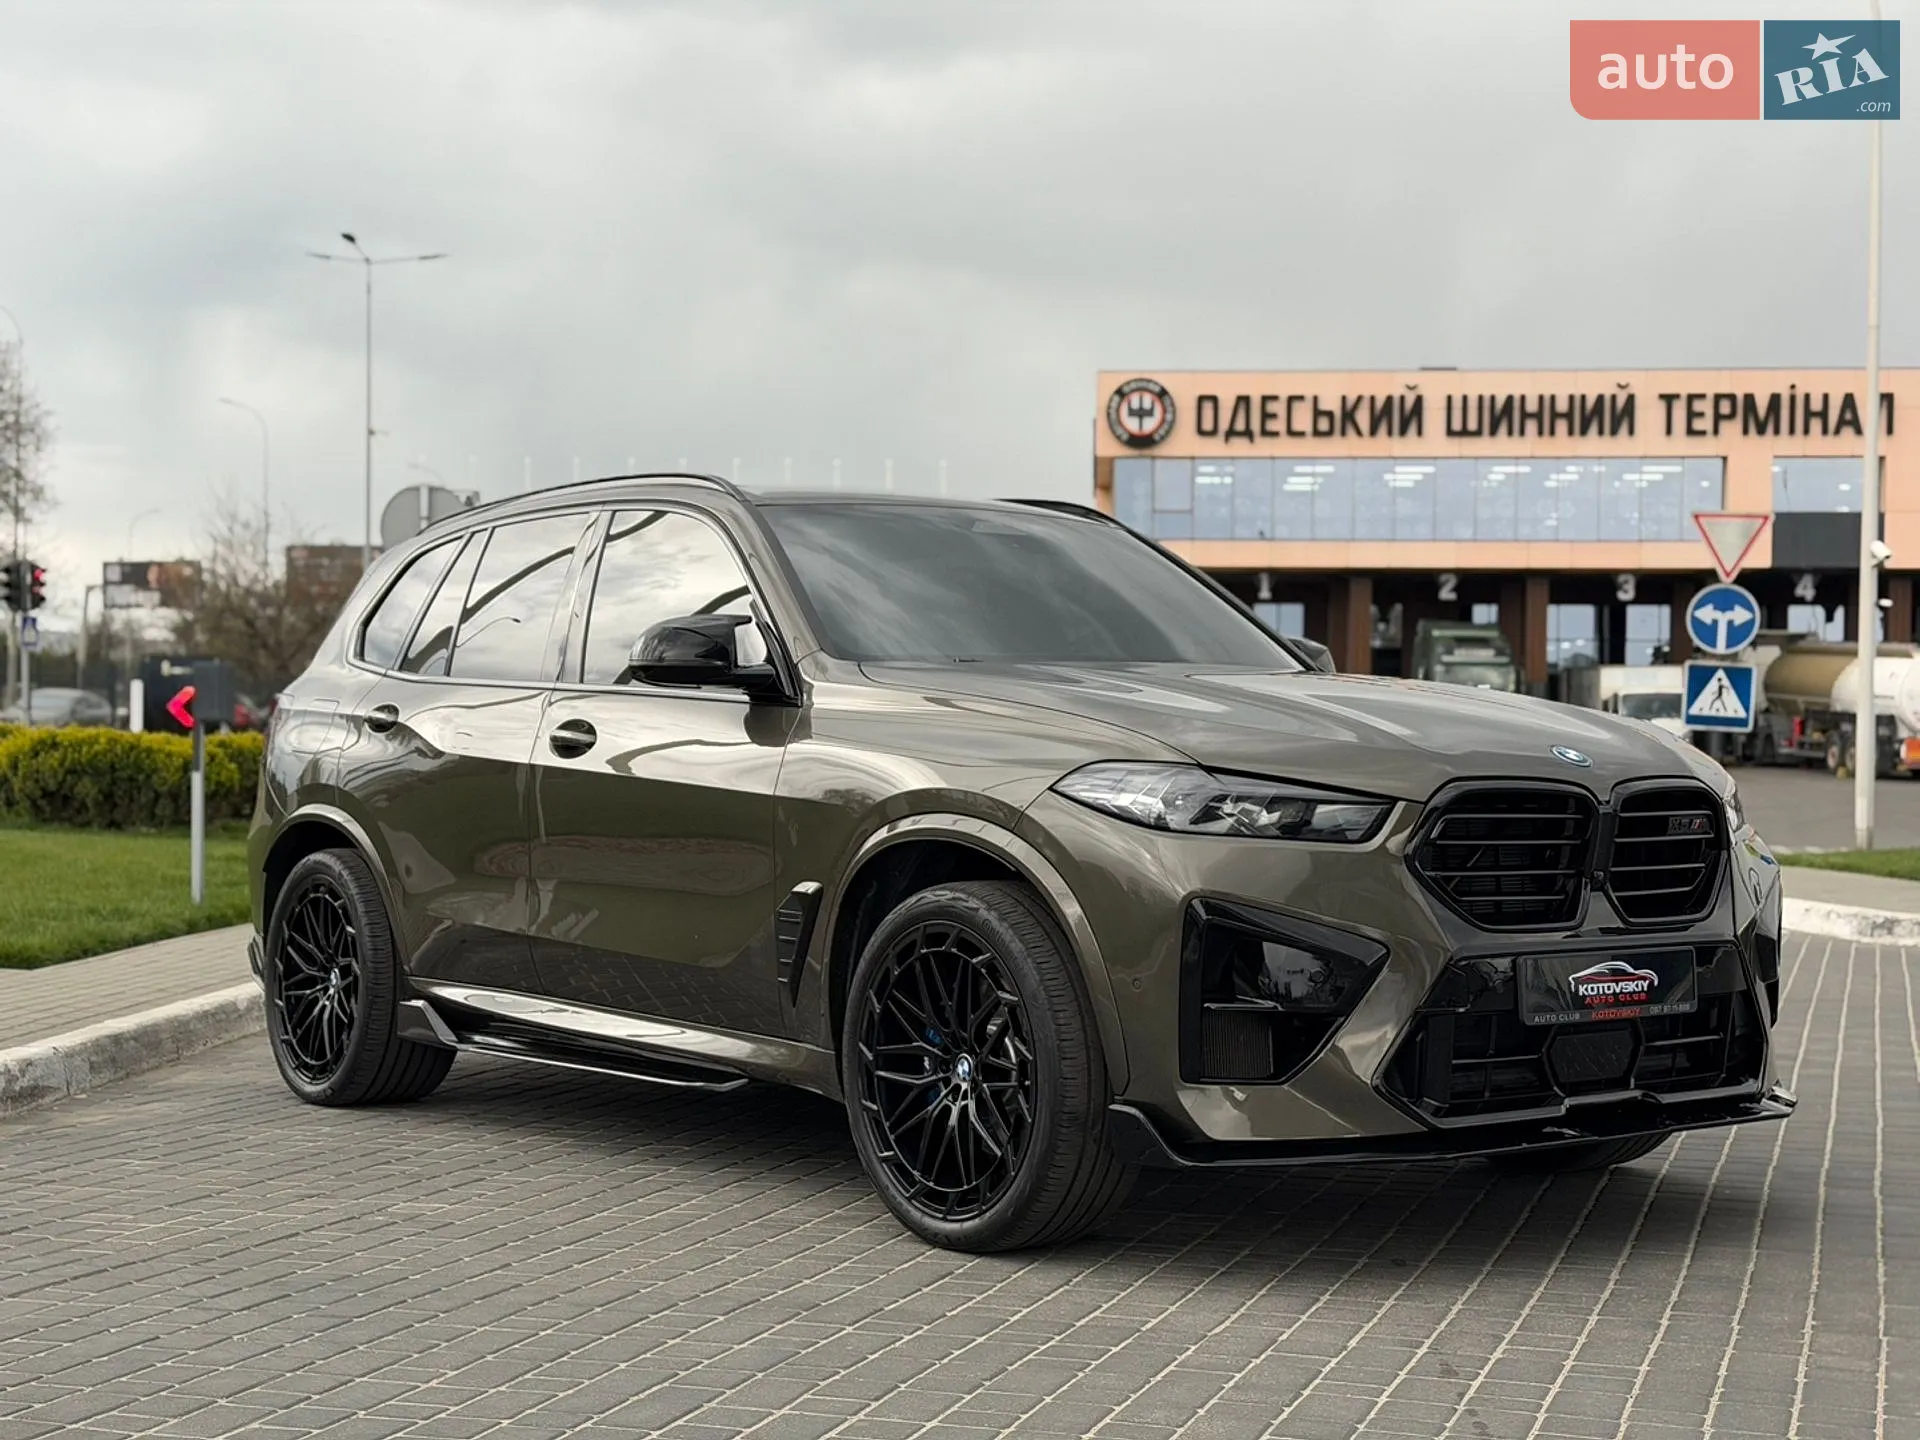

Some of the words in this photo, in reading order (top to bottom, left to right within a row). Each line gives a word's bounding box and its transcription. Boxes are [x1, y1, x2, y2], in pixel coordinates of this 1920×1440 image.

[1196, 384, 1424, 444] ОДЕСЬКИЙ
[1445, 382, 1636, 437] ШИННИЙ
[1259, 574, 1272, 599] 1
[1438, 575, 1457, 600] 2
[1616, 574, 1636, 600] 3
[1794, 573, 1817, 602] 4
[1578, 980, 1650, 996] KOTOVSKIY
[1584, 995, 1615, 1005] AUTO
[1618, 992, 1647, 1002] CLUB
[1534, 1014, 1557, 1023] AUTO
[1558, 1012, 1580, 1022] CLUB
